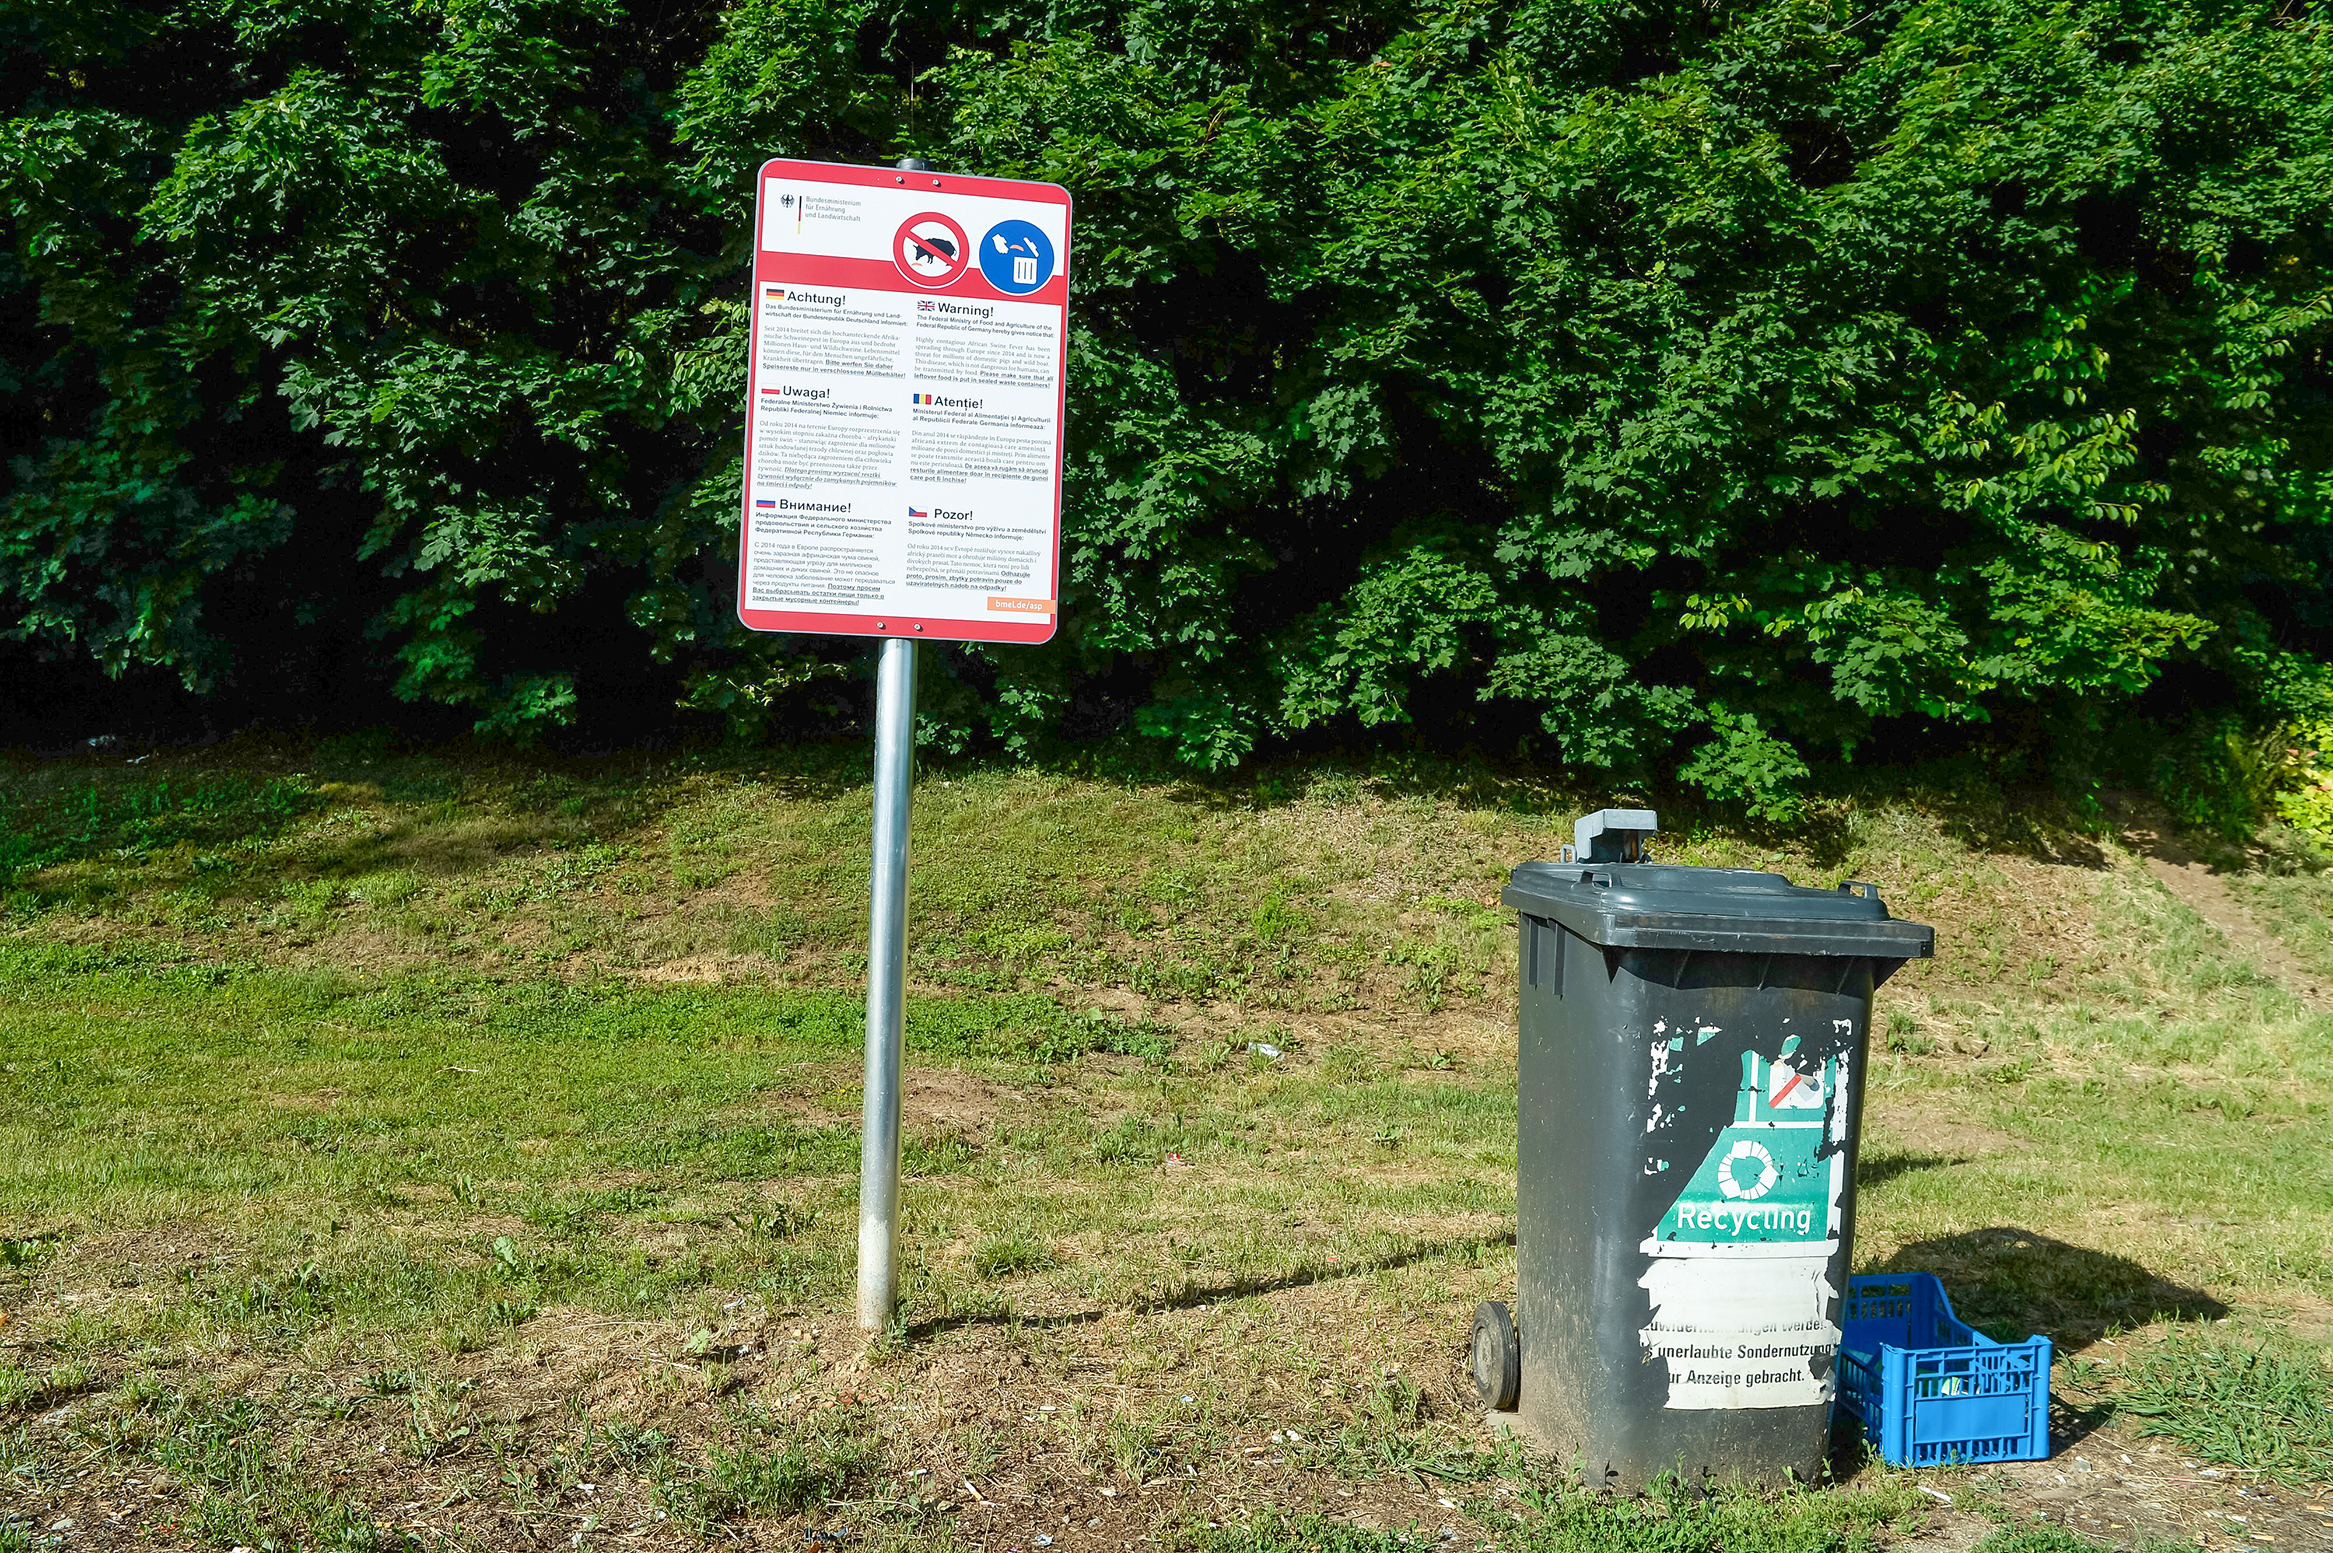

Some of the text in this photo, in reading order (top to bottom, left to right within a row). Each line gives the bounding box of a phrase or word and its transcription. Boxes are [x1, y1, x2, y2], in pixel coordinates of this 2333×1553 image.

[787, 291, 845, 307] Achtung!
[938, 303, 993, 319] Warning!
[783, 386, 830, 401] Uwaga!
[780, 499, 851, 513] Внимание!
[934, 509, 973, 520] Pozor!
[995, 600, 1043, 611] bmel.de/asp
[1677, 1202, 1811, 1237] Recycling
[1658, 1344, 1733, 1359] unerlaubte
[1687, 1370, 1741, 1388] Anzeige
[1746, 1368, 1805, 1388] gebracht.
